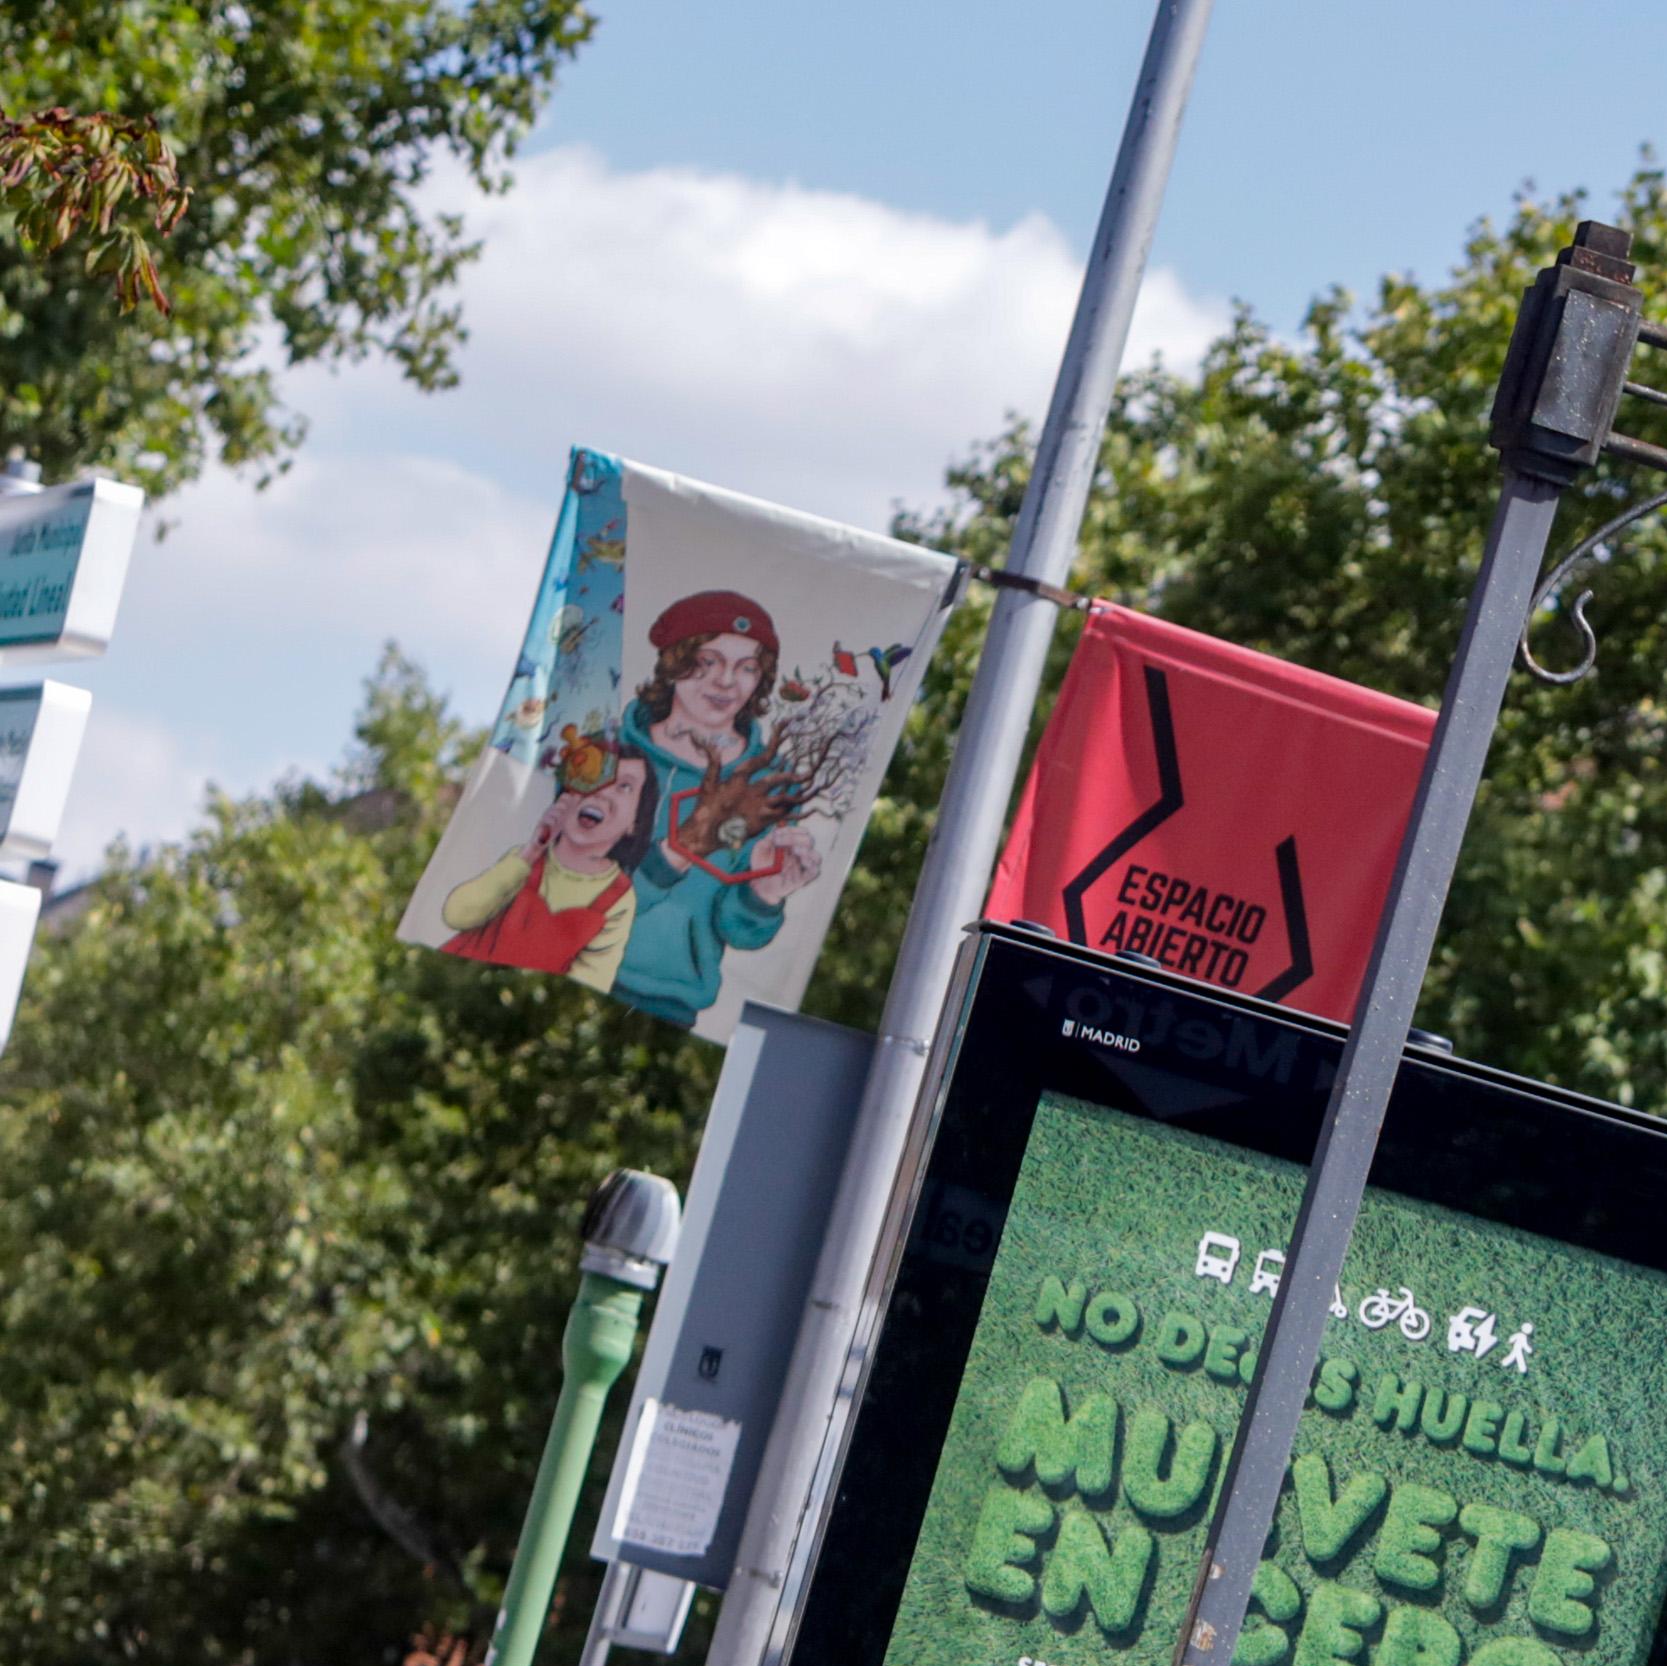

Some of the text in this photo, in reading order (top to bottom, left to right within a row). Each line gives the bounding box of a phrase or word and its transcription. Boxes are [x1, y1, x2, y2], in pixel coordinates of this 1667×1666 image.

[1100, 910, 1250, 987] ABIERTO
[1117, 864, 1267, 945] ESPACIO
[1080, 1025, 1141, 1053] MADRID
[1034, 1274, 1633, 1493] NO DES HUELLA.
[965, 1489, 1156, 1634] EN
[997, 1378, 1612, 1637] MUVETE
